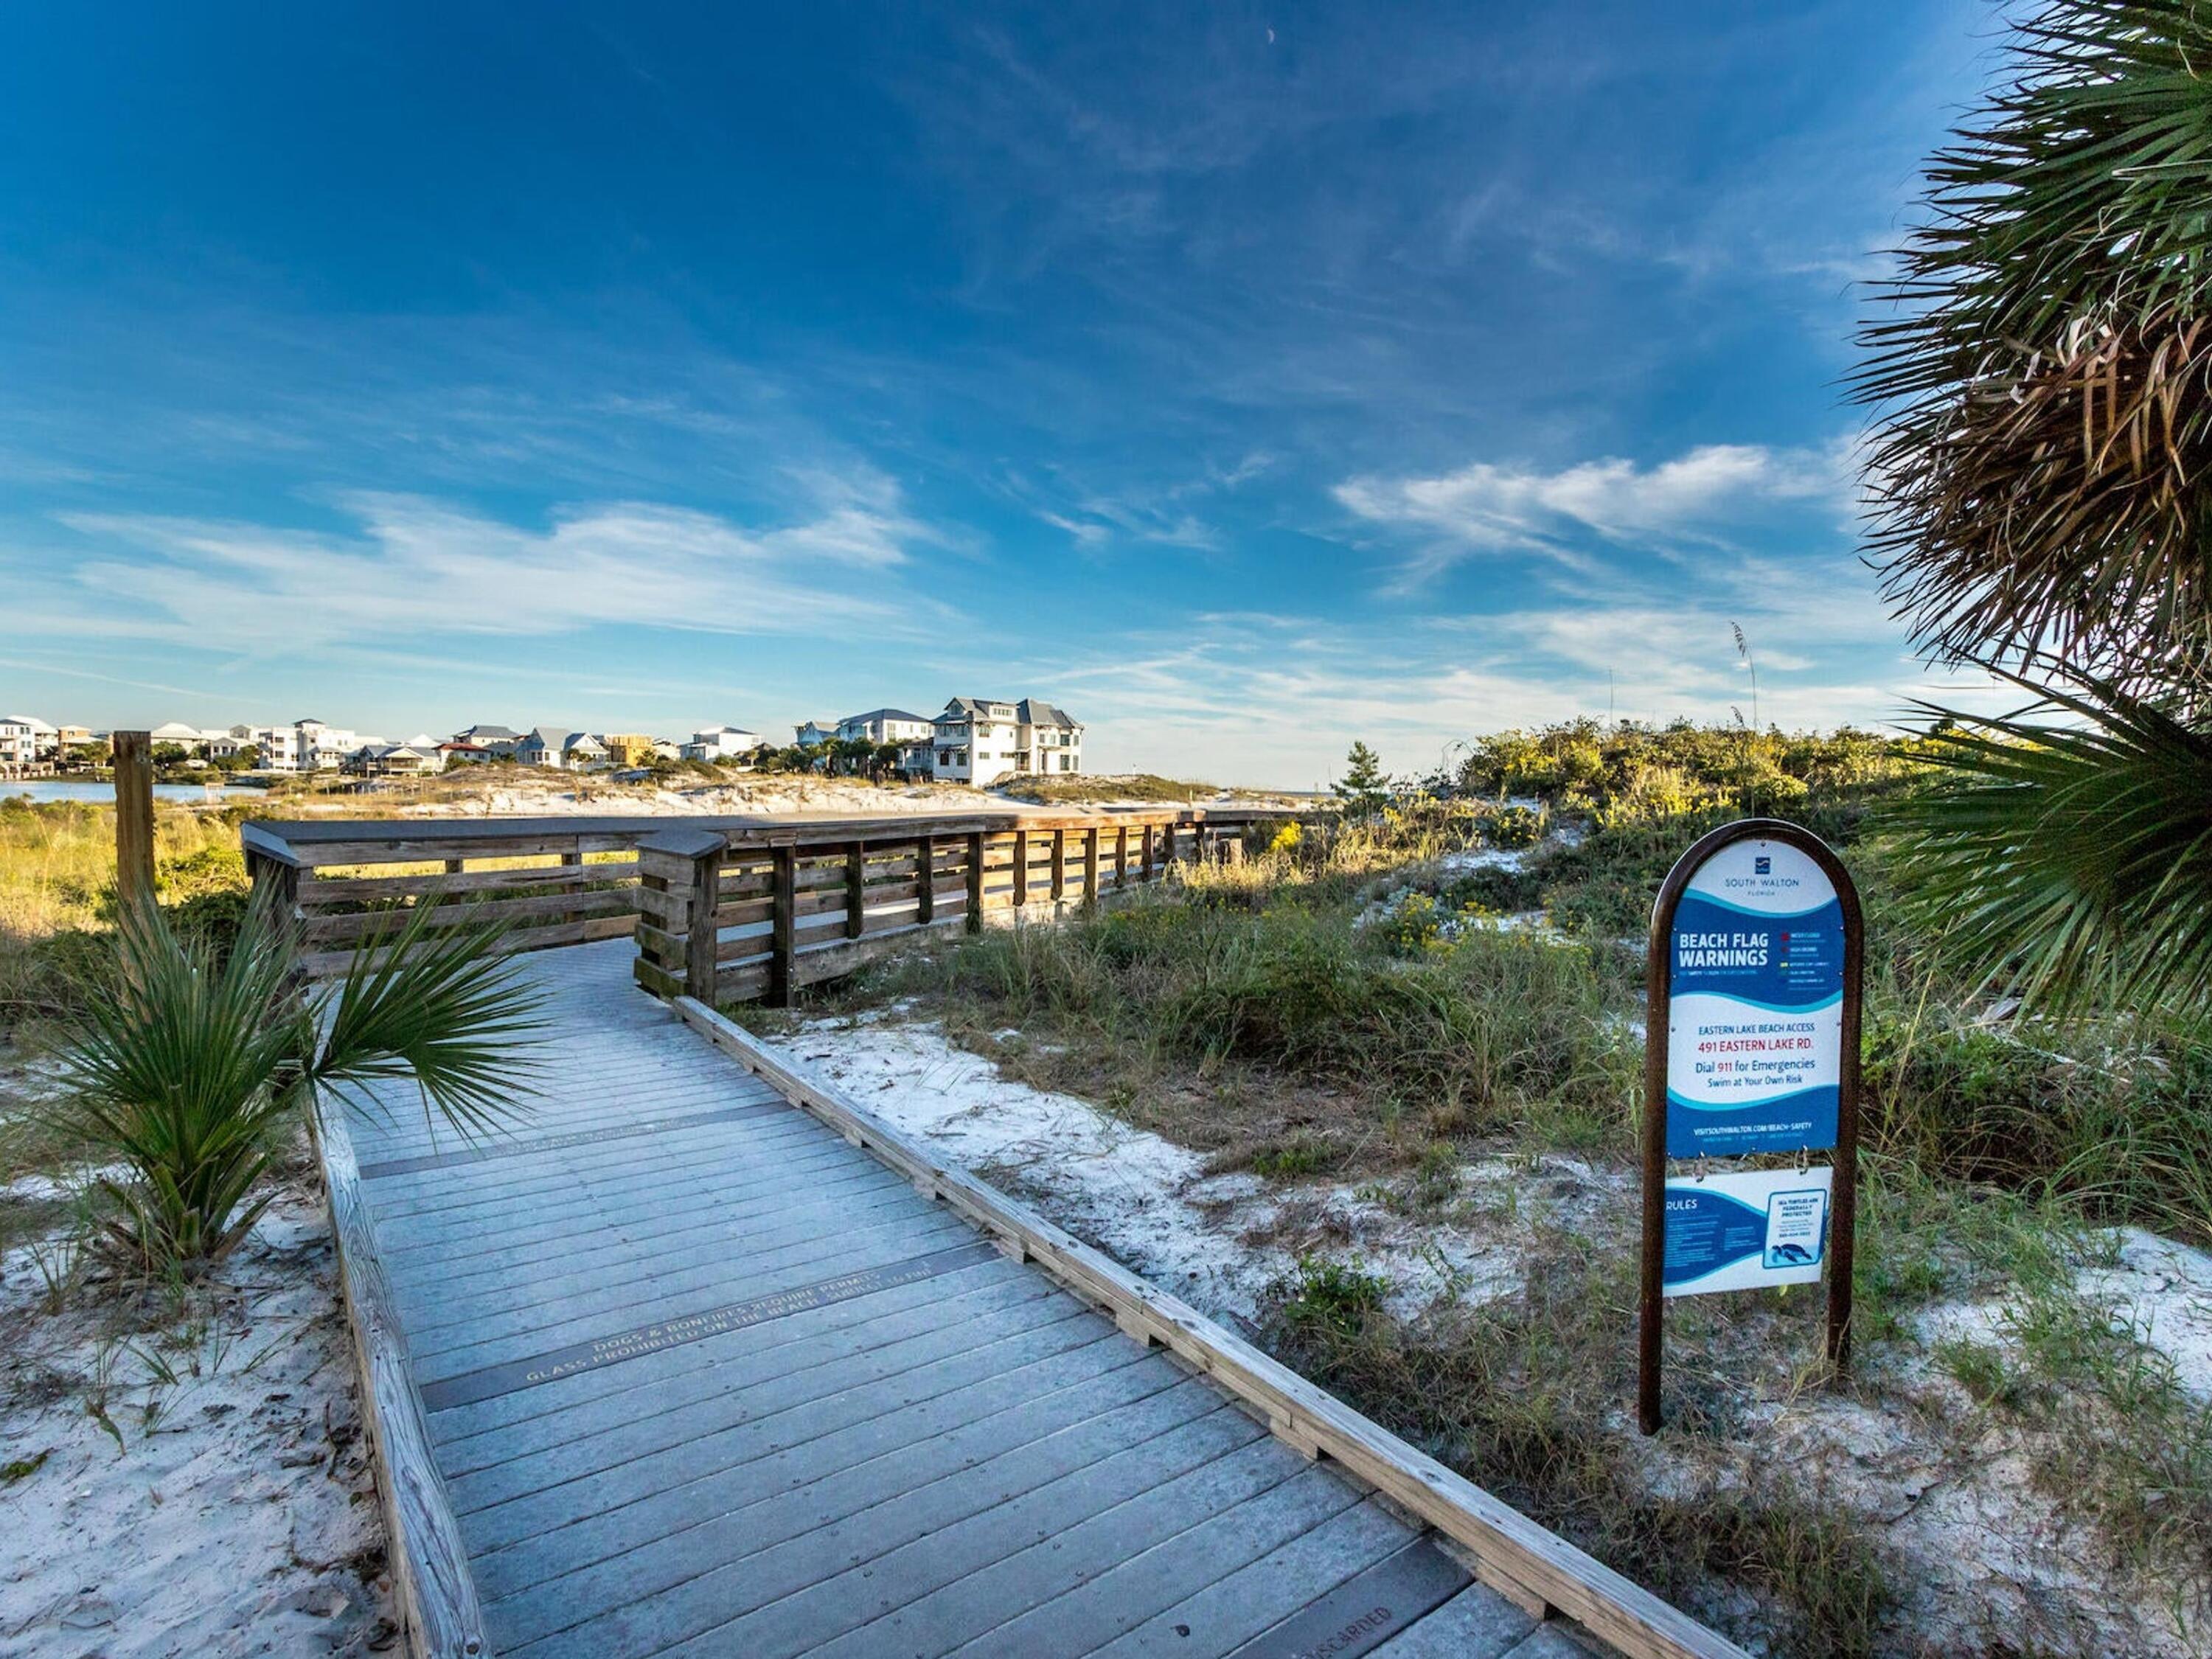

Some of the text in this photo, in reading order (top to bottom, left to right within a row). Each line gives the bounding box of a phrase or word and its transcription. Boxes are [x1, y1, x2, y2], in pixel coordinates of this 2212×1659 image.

[1725, 878, 1799, 887] SOUTH WALTON
[1680, 933, 1768, 948] BEACH FLAG
[1679, 949, 1768, 967] WARNINGS
[1698, 1022, 1815, 1035] EASTERN LAKE BEACH ACCESS
[1698, 1037, 1814, 1053] 491 EASTERN LAKE RD.
[1696, 1057, 1815, 1074] Dial 911 for Emergencies
[1707, 1074, 1803, 1088] Swim at Your Own Risk
[1666, 1198, 1698, 1211] RULES
[593, 1333, 643, 1352] DOGS
[667, 1308, 746, 1333] BONFIRES
[751, 1289, 815, 1311] REQUIRE
[526, 1359, 587, 1381] GLASS
[592, 1330, 698, 1363] PROHIBITED
[703, 1321, 728, 1333] ON
